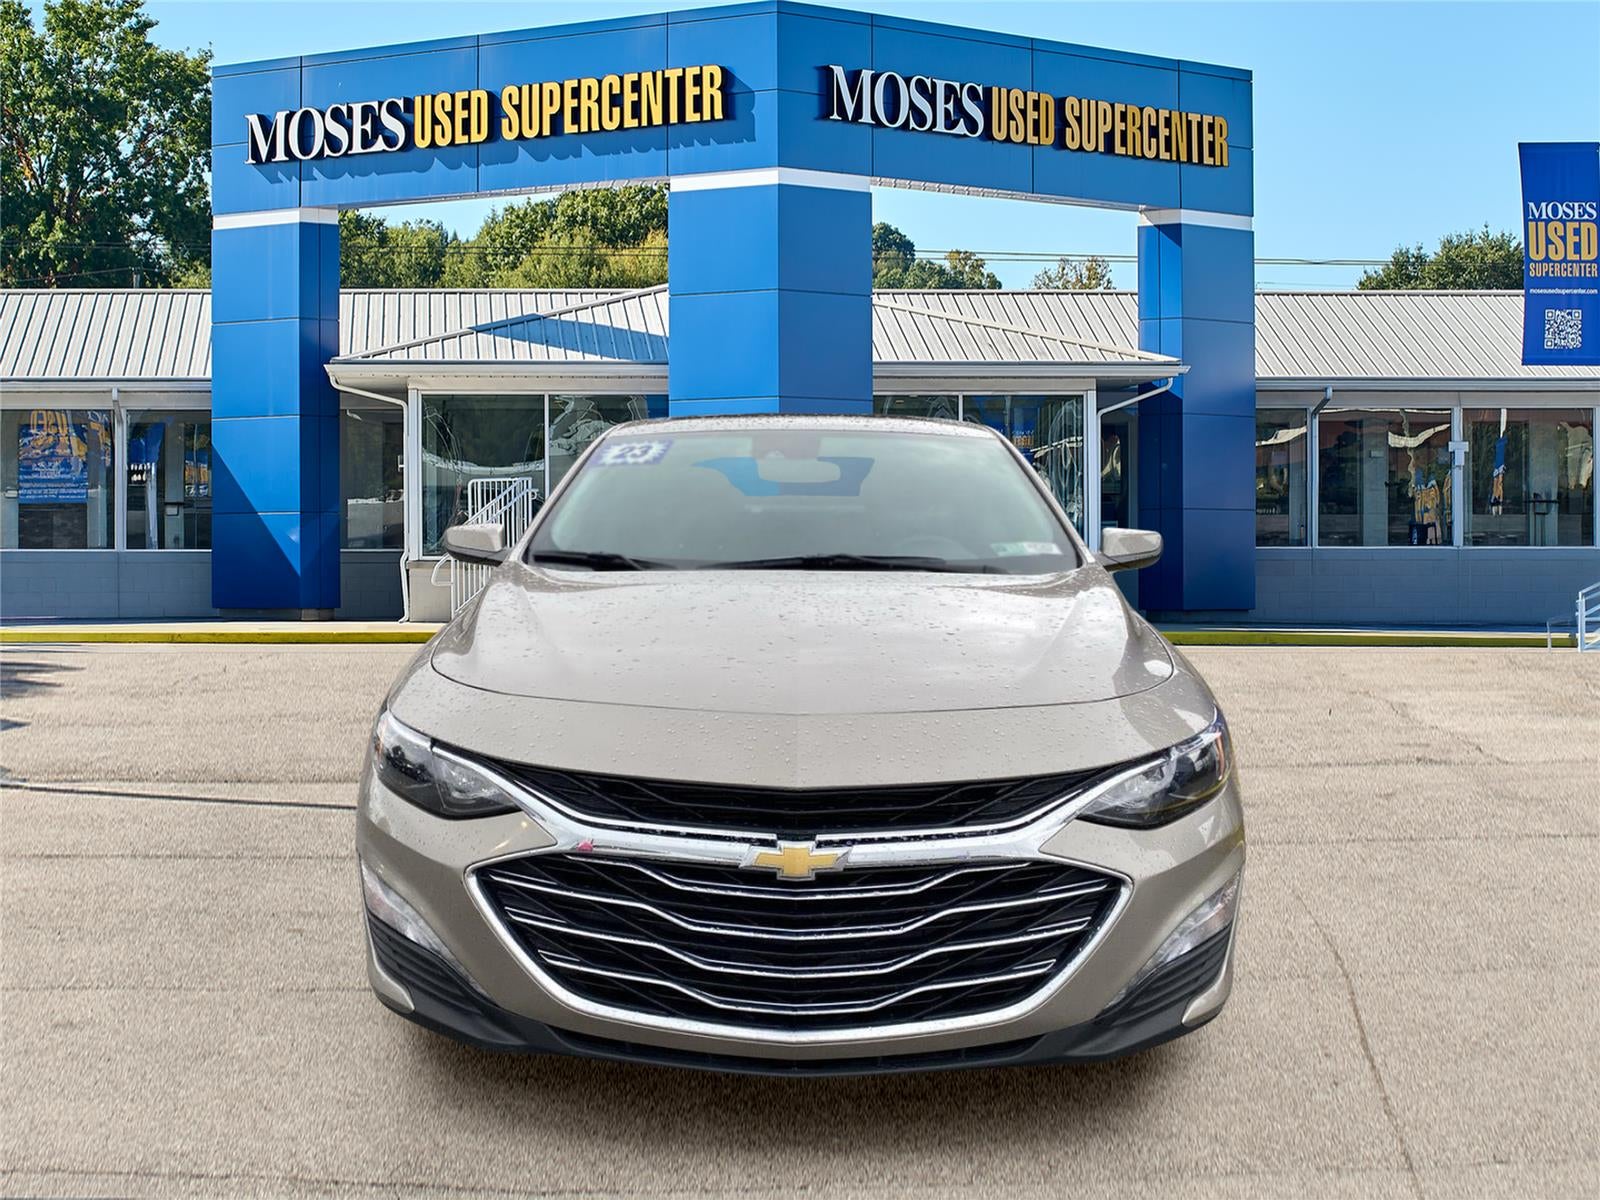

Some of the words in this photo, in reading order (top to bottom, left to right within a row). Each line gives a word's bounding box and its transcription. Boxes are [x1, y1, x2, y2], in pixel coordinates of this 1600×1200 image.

[245, 97, 406, 165] MOSES
[413, 89, 489, 149] USED
[501, 64, 724, 141] SUPERCENTER
[829, 64, 985, 138] MOSES
[990, 86, 1055, 146] USED
[1065, 96, 1229, 167] SUPERCENTER
[1527, 201, 1597, 220] MOSES
[1528, 221, 1598, 261] USED
[1529, 262, 1598, 278] SUPERCENTER
